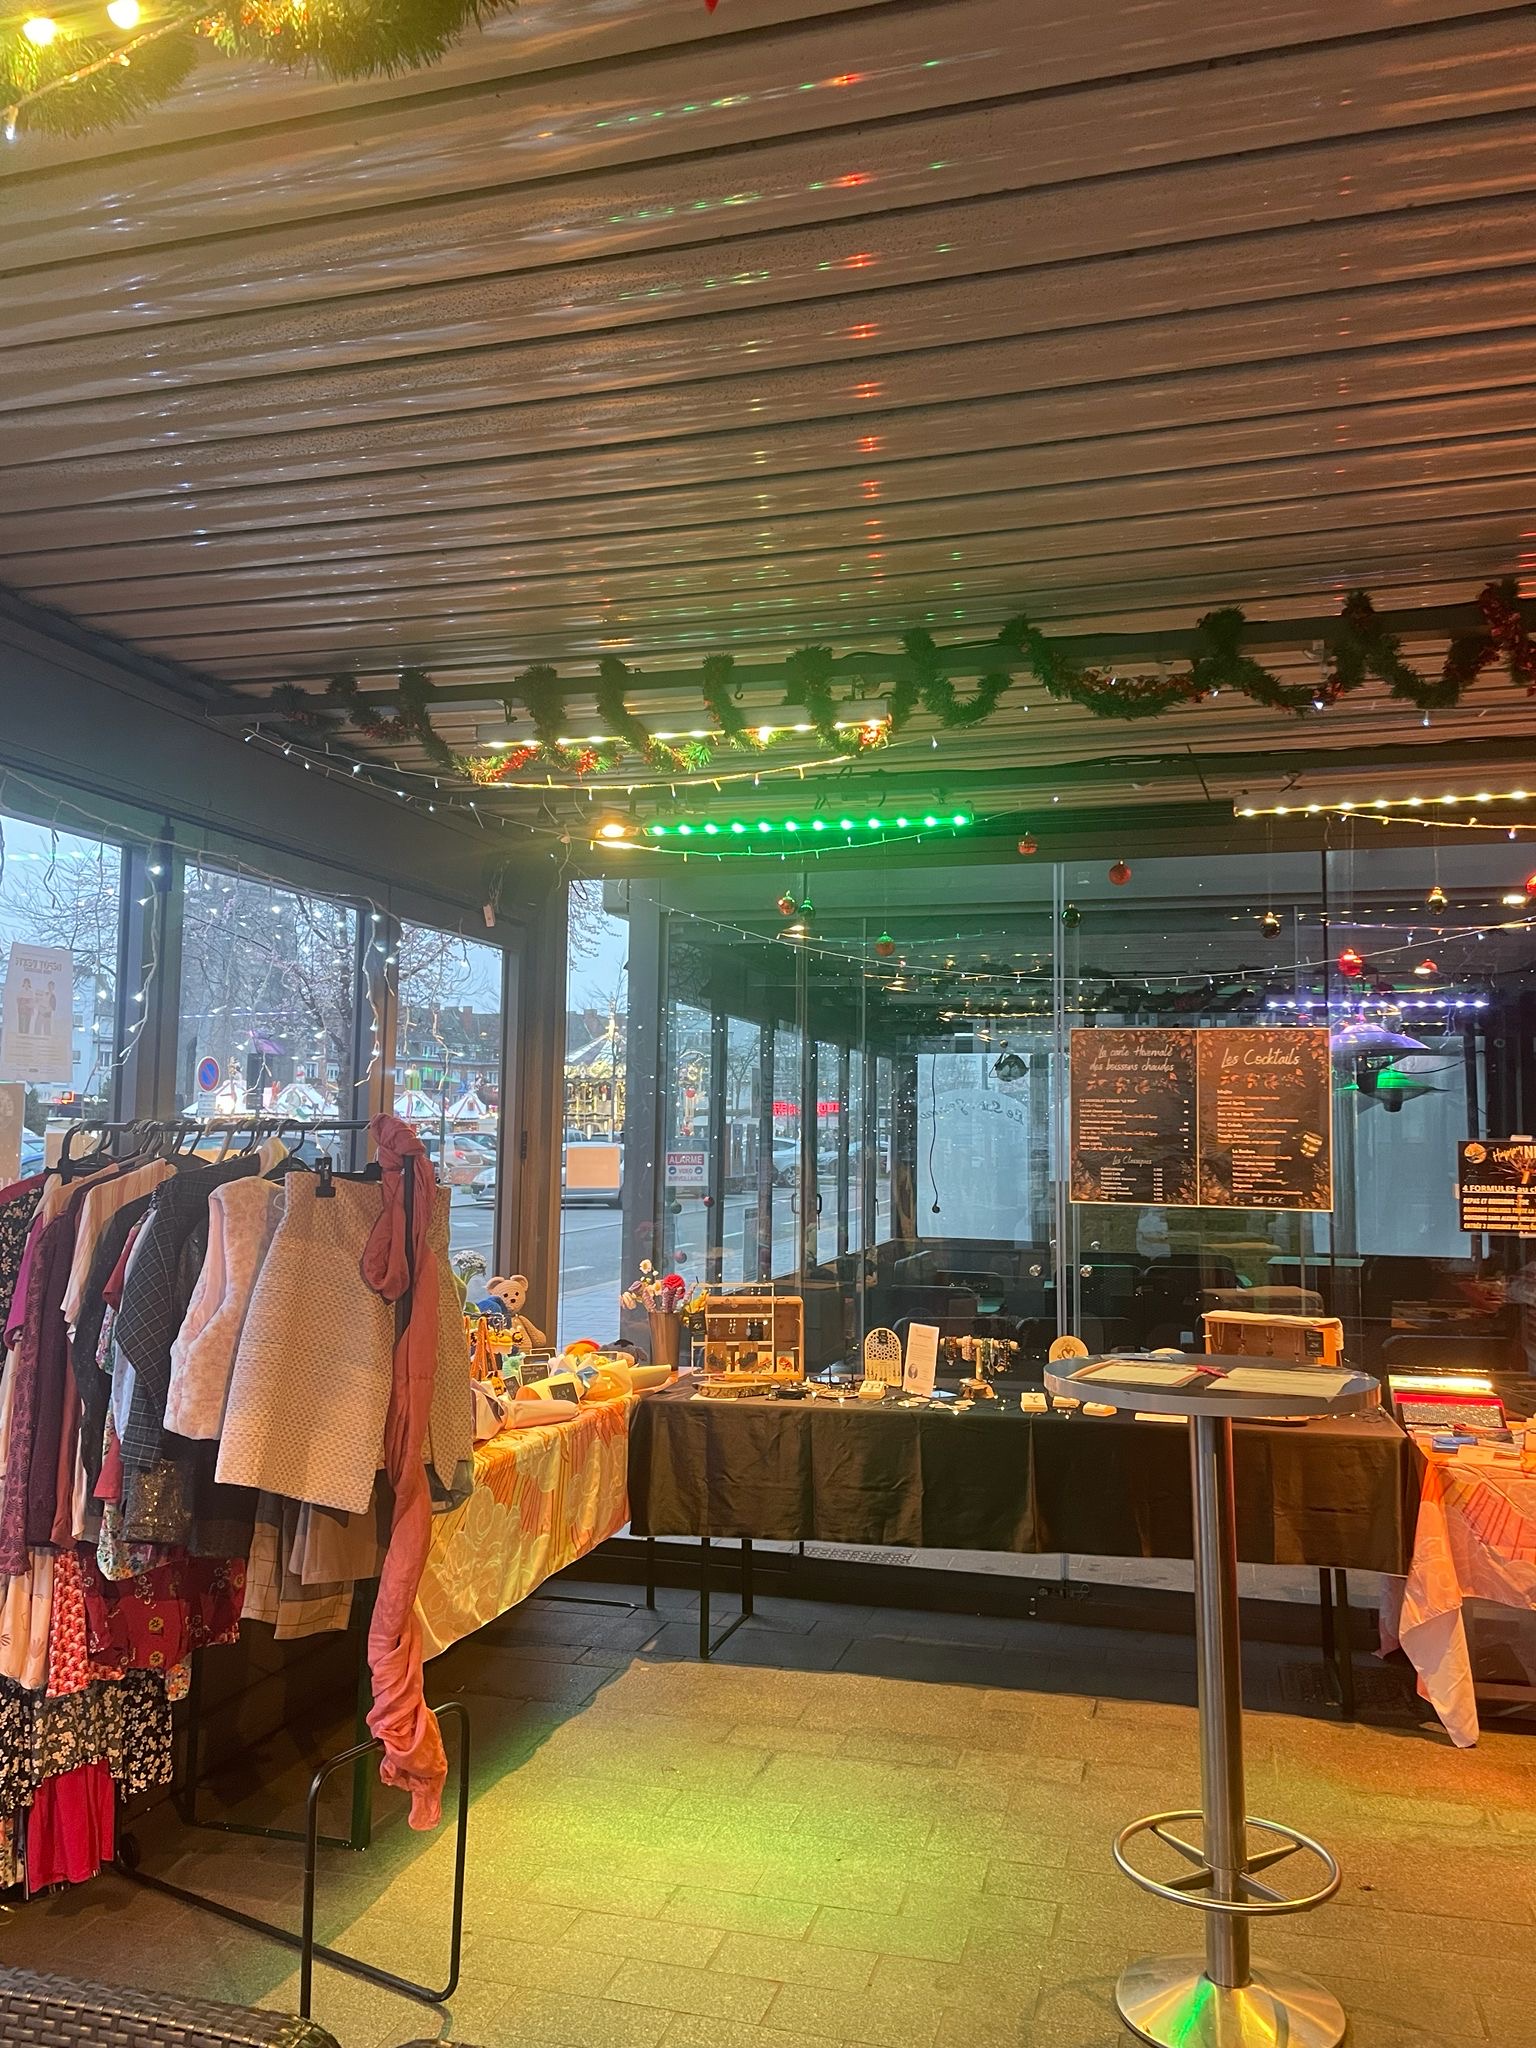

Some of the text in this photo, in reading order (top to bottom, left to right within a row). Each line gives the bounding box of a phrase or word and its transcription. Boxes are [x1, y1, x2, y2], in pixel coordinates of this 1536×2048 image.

[1110, 1045, 1130, 1057] carte
[1090, 1057, 1174, 1072] des boissons chaudes
[1221, 1048, 1300, 1068] Les Cocktails
[668, 1155, 703, 1164] ALARME
